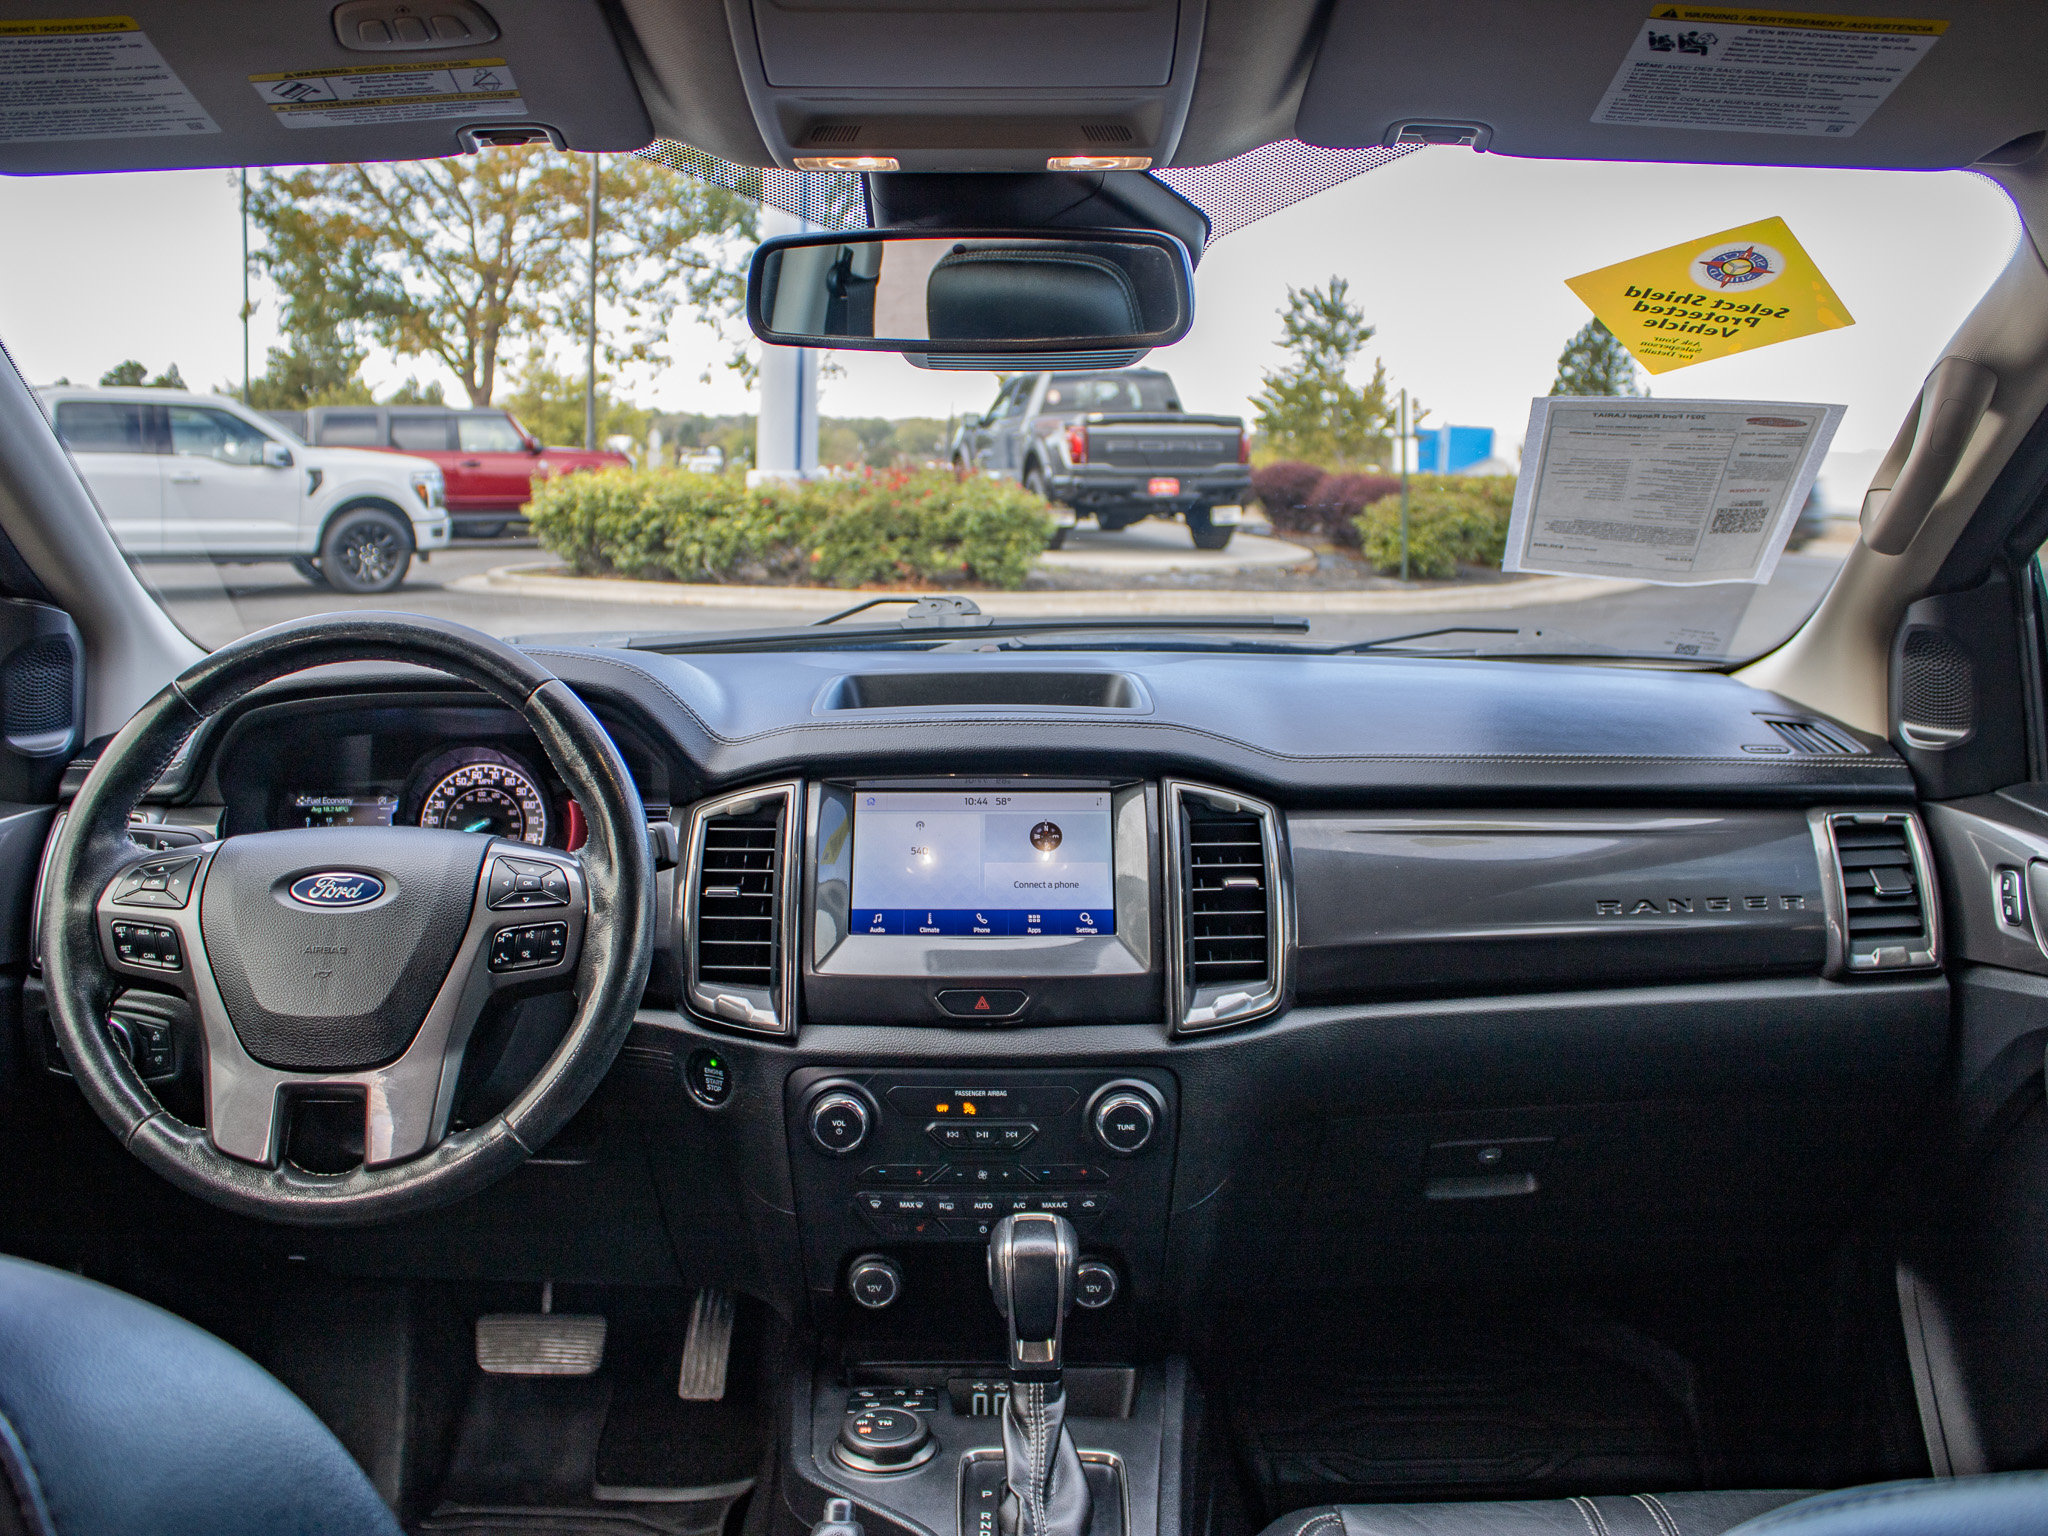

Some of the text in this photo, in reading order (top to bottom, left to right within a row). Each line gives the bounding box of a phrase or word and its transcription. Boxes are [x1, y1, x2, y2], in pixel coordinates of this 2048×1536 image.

[1684, 11, 1738, 20] WARNING
[1747, 15, 1845, 28] AVERTISSEMENT
[471, 771, 482, 779] 60
[489, 771, 499, 779] 70
[456, 778, 467, 786] 50
[504, 778, 516, 786] 80
[444, 787, 455, 796] 40
[516, 788, 527, 796] 90
[322, 797, 353, 806] Economy
[434, 801, 445, 809] 30
[522, 801, 536, 809] 100
[964, 797, 1012, 806] 10:44 58°
[427, 816, 438, 824] 20
[528, 816, 539, 824] 110
[525, 833, 538, 842] 120
[308, 877, 364, 899] Ford
[1013, 880, 1046, 889] Connect
[1054, 880, 1080, 890] phone
[1596, 895, 1805, 915] RANGER
[869, 926, 886, 934] Audio
[919, 926, 940, 934] Climate
[973, 926, 991, 934] Phone
[304, 945, 348, 954] AIRBAG
[936, 1103, 949, 1113] OFF
[1116, 1123, 1136, 1131] TUNE
[899, 1201, 915, 1209] MAX
[866, 1284, 882, 1293] 12V
[1085, 1284, 1102, 1293] 12V
[981, 1489, 993, 1499] P
[980, 1511, 992, 1521] R
[980, 1521, 992, 1530] N
